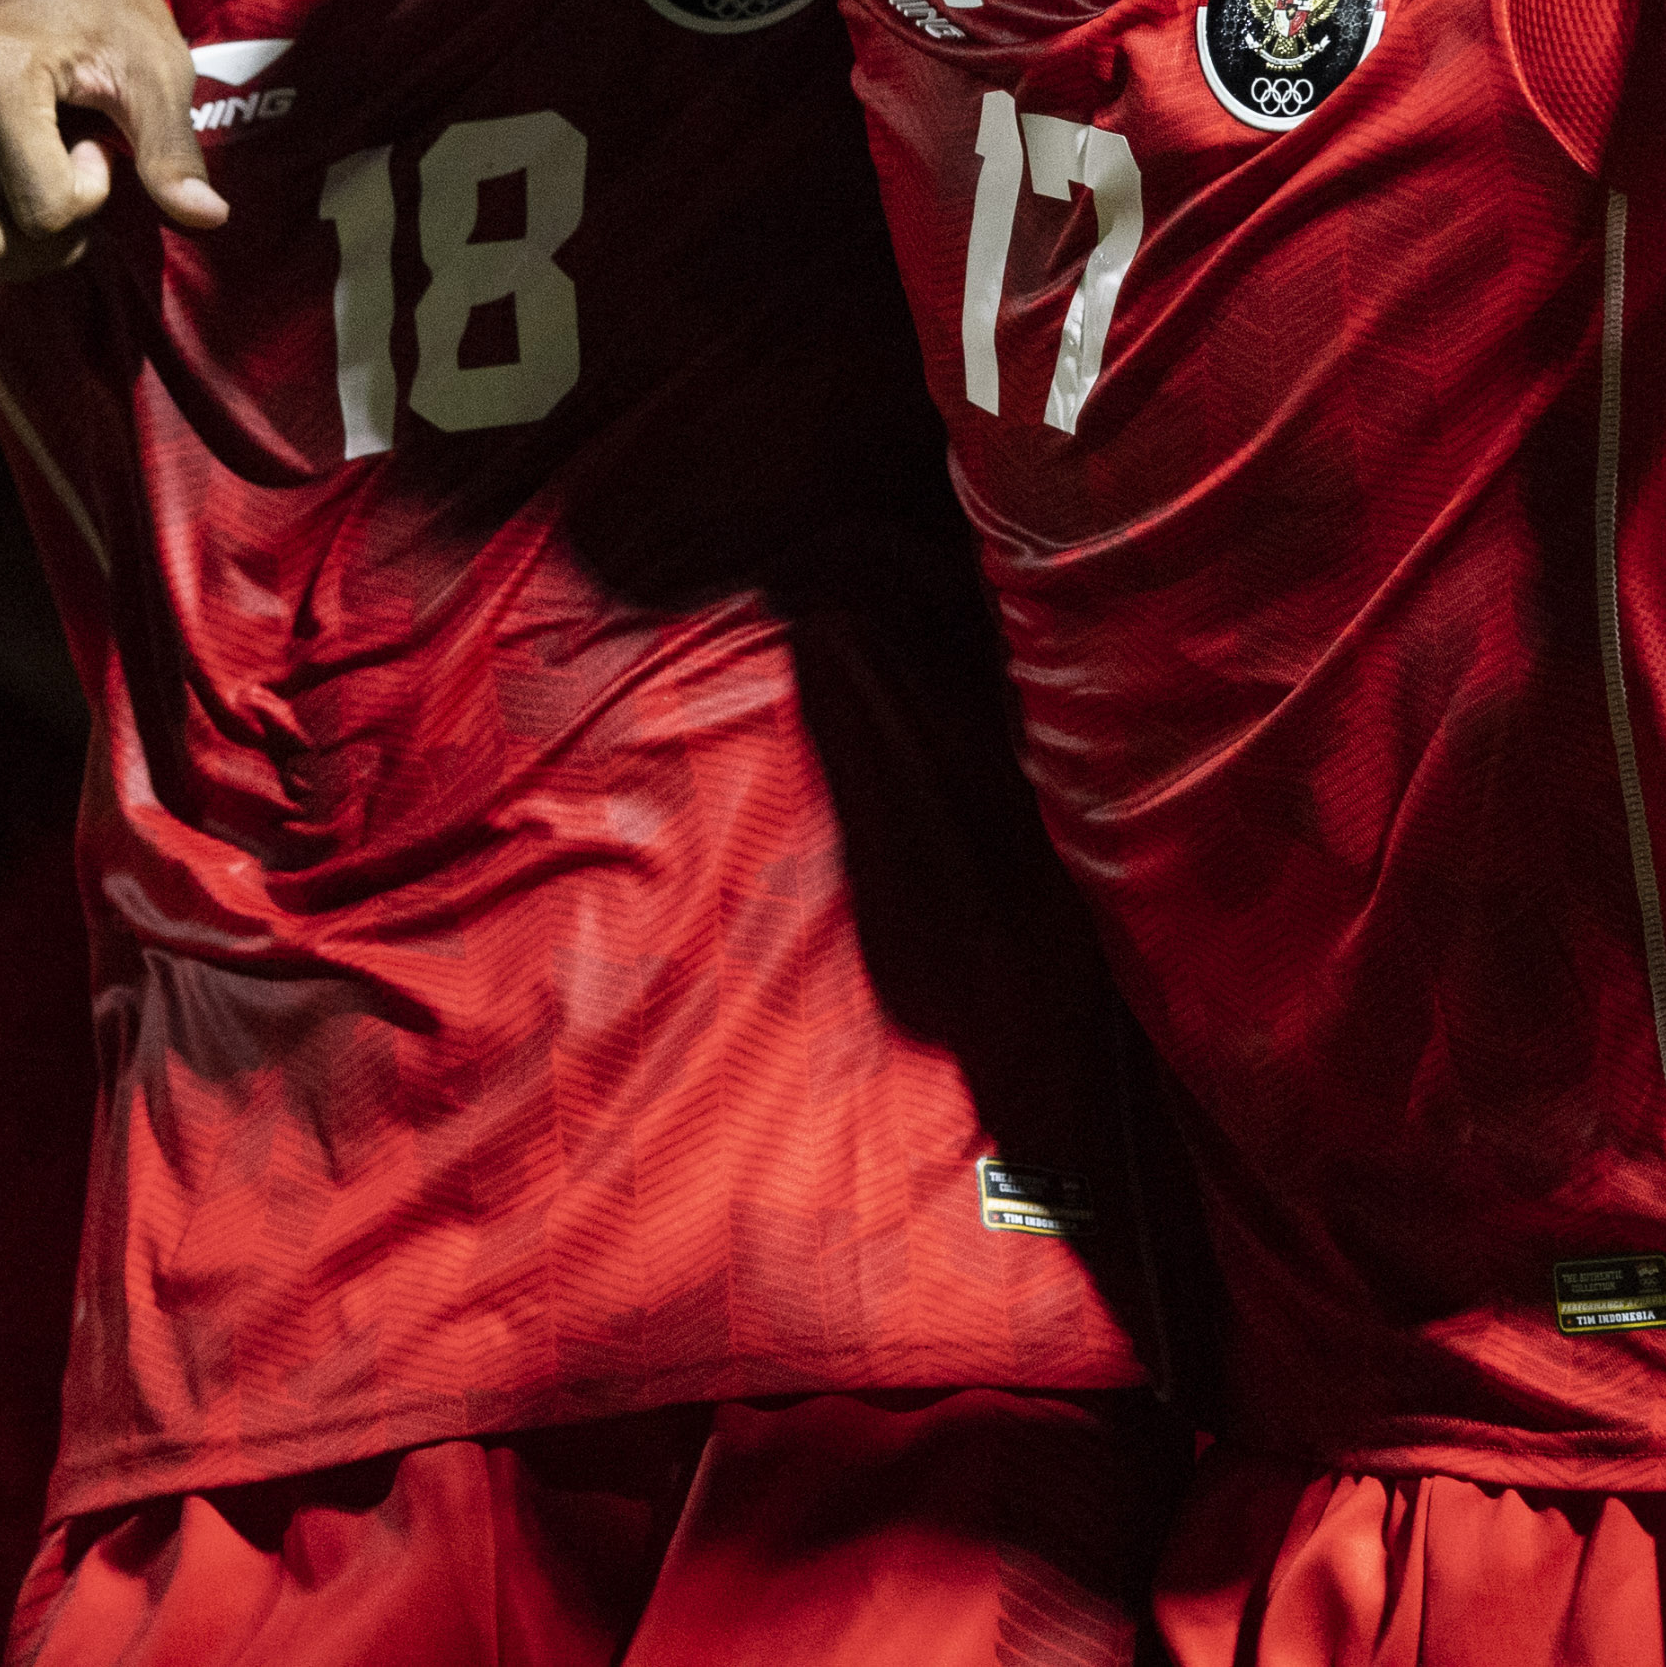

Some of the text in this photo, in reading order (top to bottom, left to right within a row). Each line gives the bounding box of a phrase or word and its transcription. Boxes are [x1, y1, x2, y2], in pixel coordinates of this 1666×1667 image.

[189, 86, 297, 132] NING
[318, 109, 589, 462] 18
[962, 89, 1145, 437] 17
[1003, 1213, 1024, 1224] TIM
[1576, 1310, 1656, 1325] TIM INDONESIA
